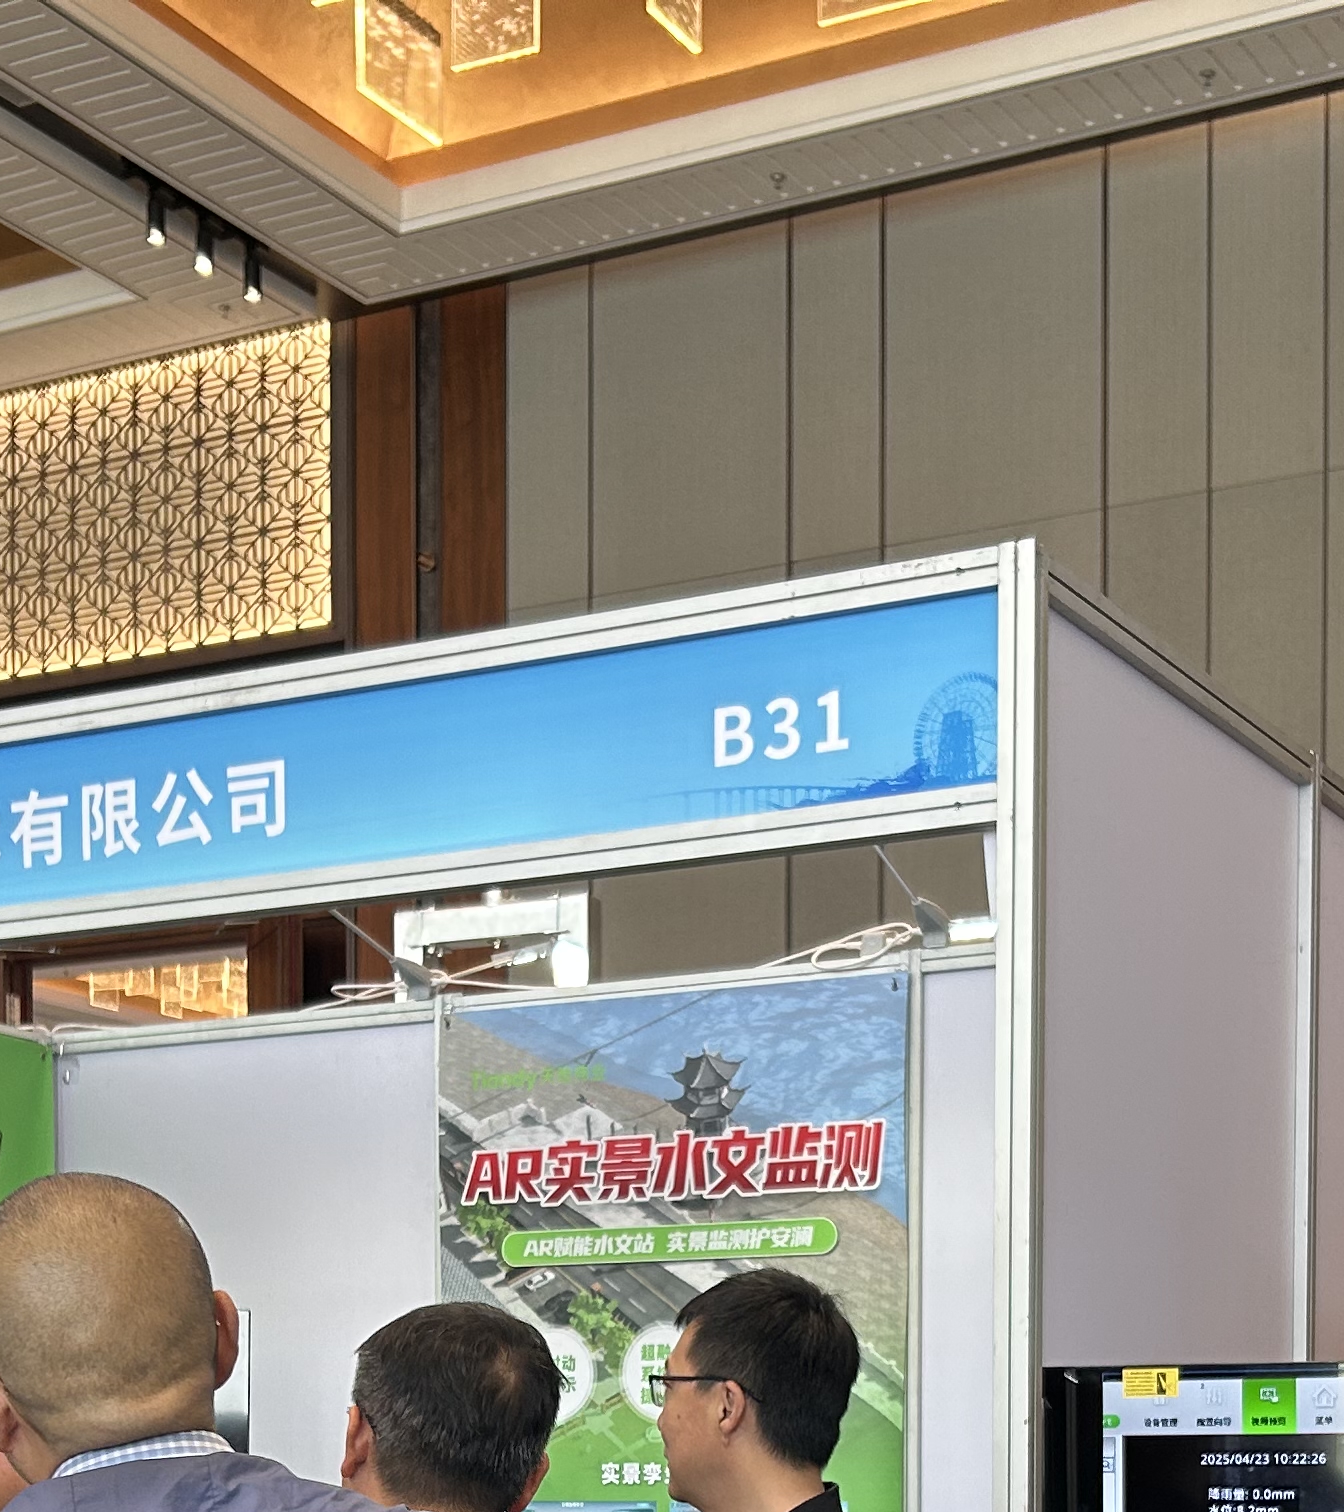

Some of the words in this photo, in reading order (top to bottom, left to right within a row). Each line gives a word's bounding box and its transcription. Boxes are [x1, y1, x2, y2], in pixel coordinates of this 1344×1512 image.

[711, 688, 850, 770] B31
[462, 1120, 884, 1205] AR实景水文监测
[523, 1232, 654, 1258] AR赋能水文站
[666, 1226, 813, 1254] 实景监测护安澜
[1200, 1453, 1269, 1466] 2025/04/23
[1274, 1453, 1327, 1466] 10:22:26
[600, 1462, 670, 1486] 实景孪
[1252, 1489, 1295, 1501] 0.0mm
